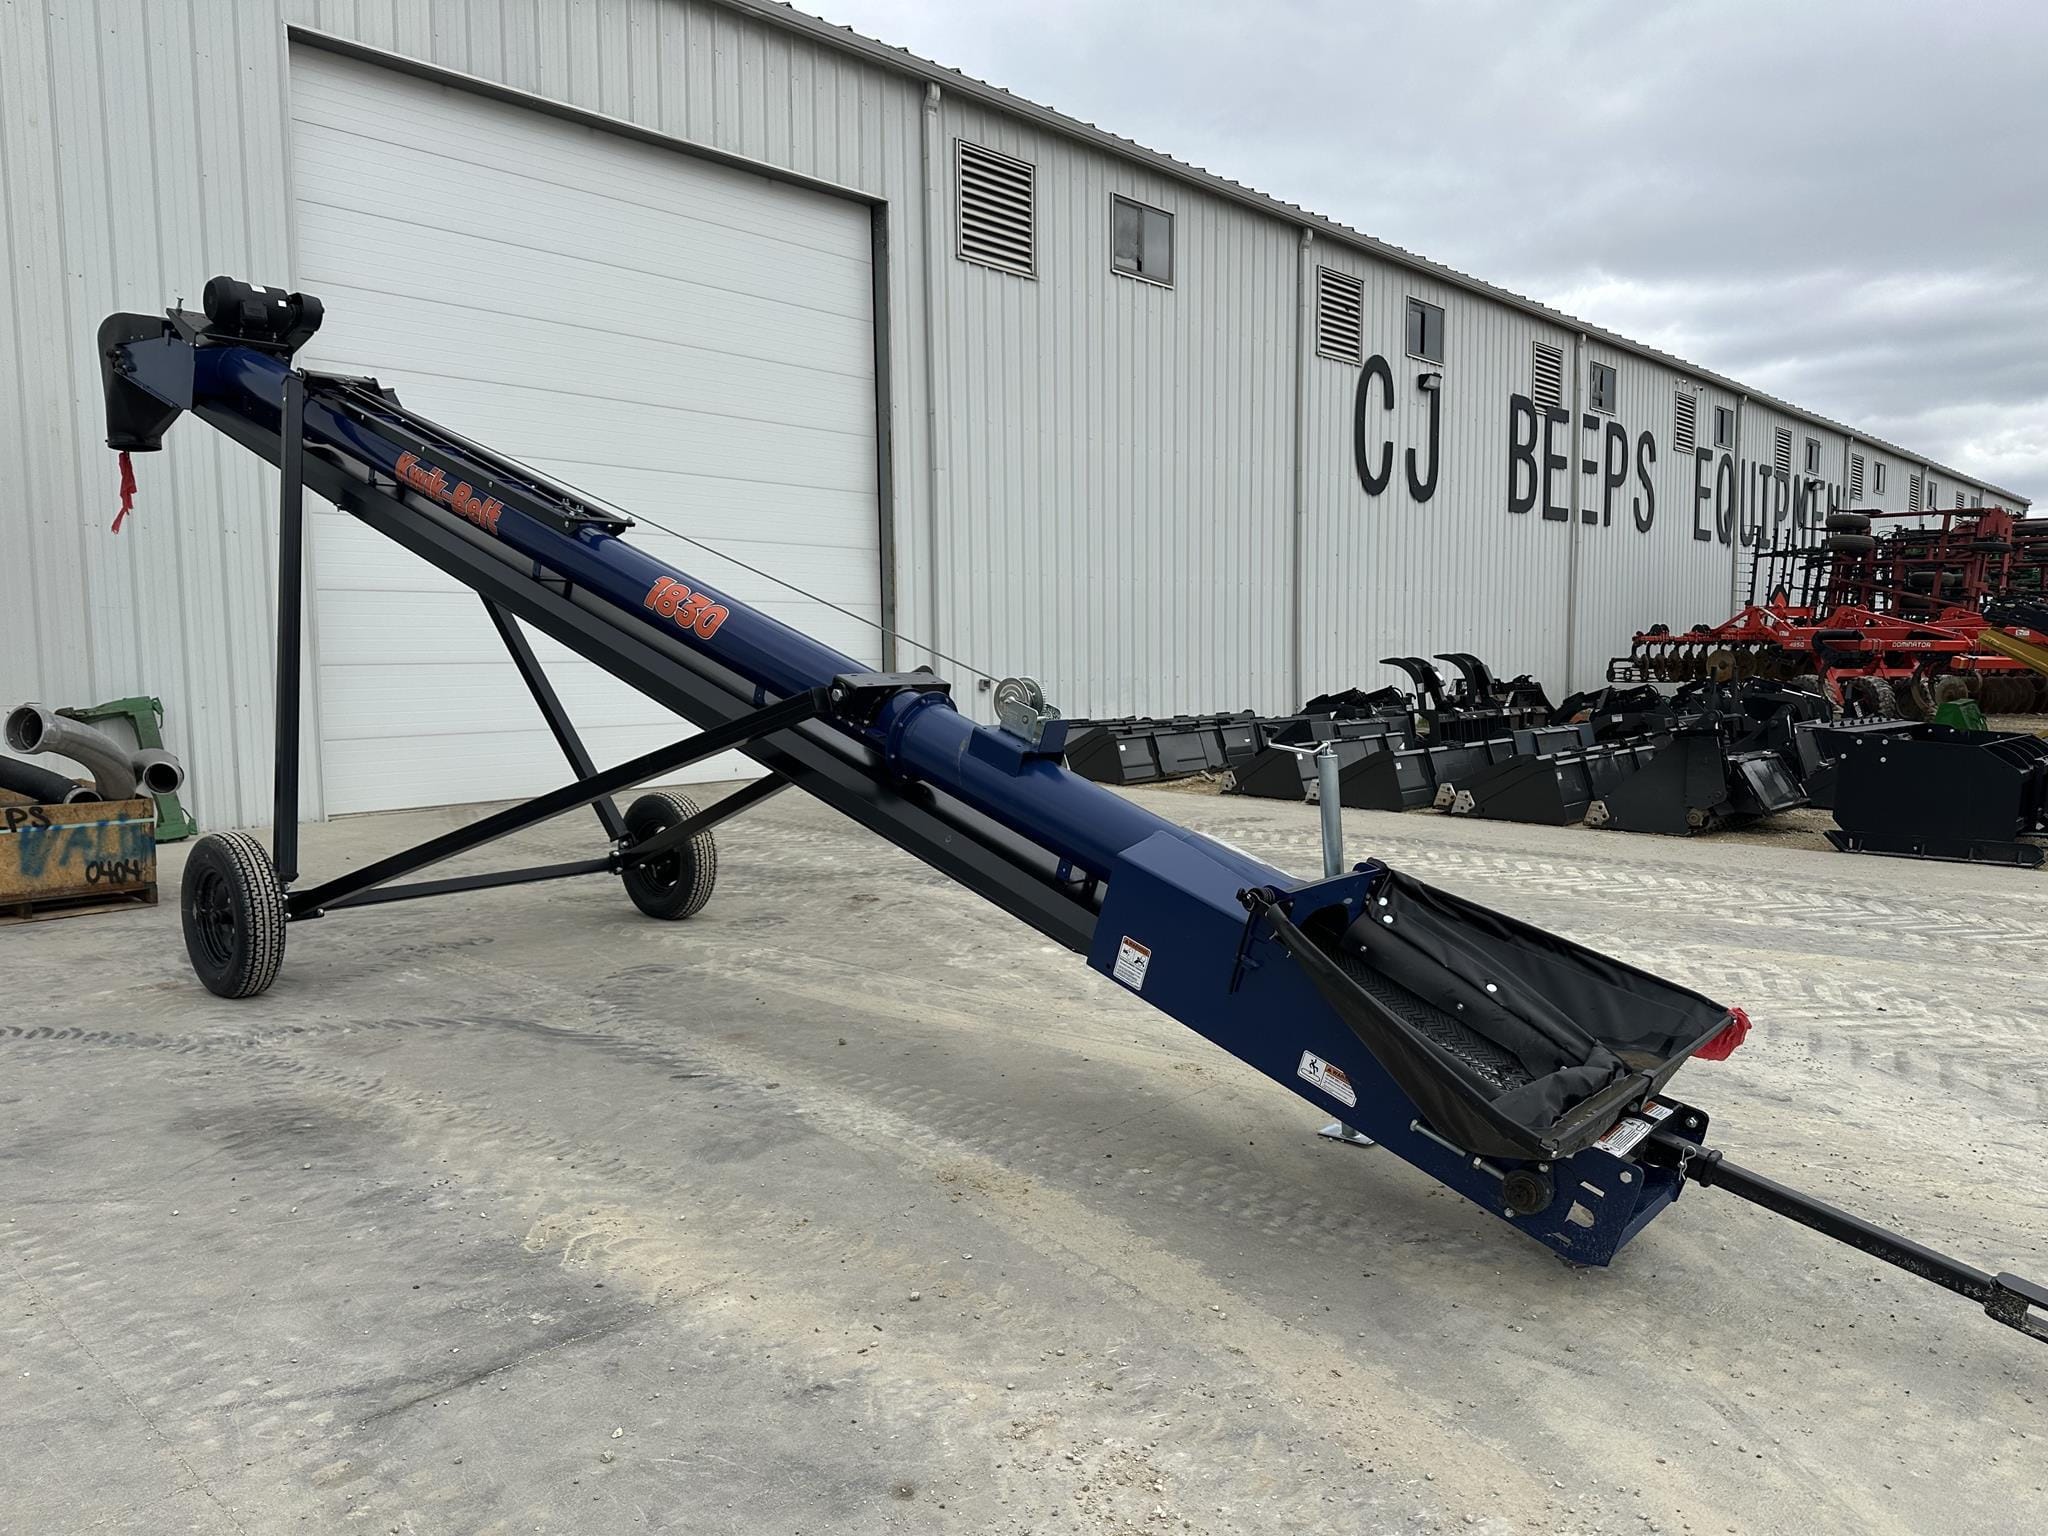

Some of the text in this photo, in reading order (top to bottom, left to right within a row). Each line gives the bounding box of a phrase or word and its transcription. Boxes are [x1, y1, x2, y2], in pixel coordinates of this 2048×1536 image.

[1354, 354, 1853, 551] CJ BEEPS EQUIPMEN
[395, 450, 504, 536] Kwik-Belt
[643, 575, 730, 640] 1830
[0, 806, 52, 833] PS
[85, 858, 143, 885] 0404
